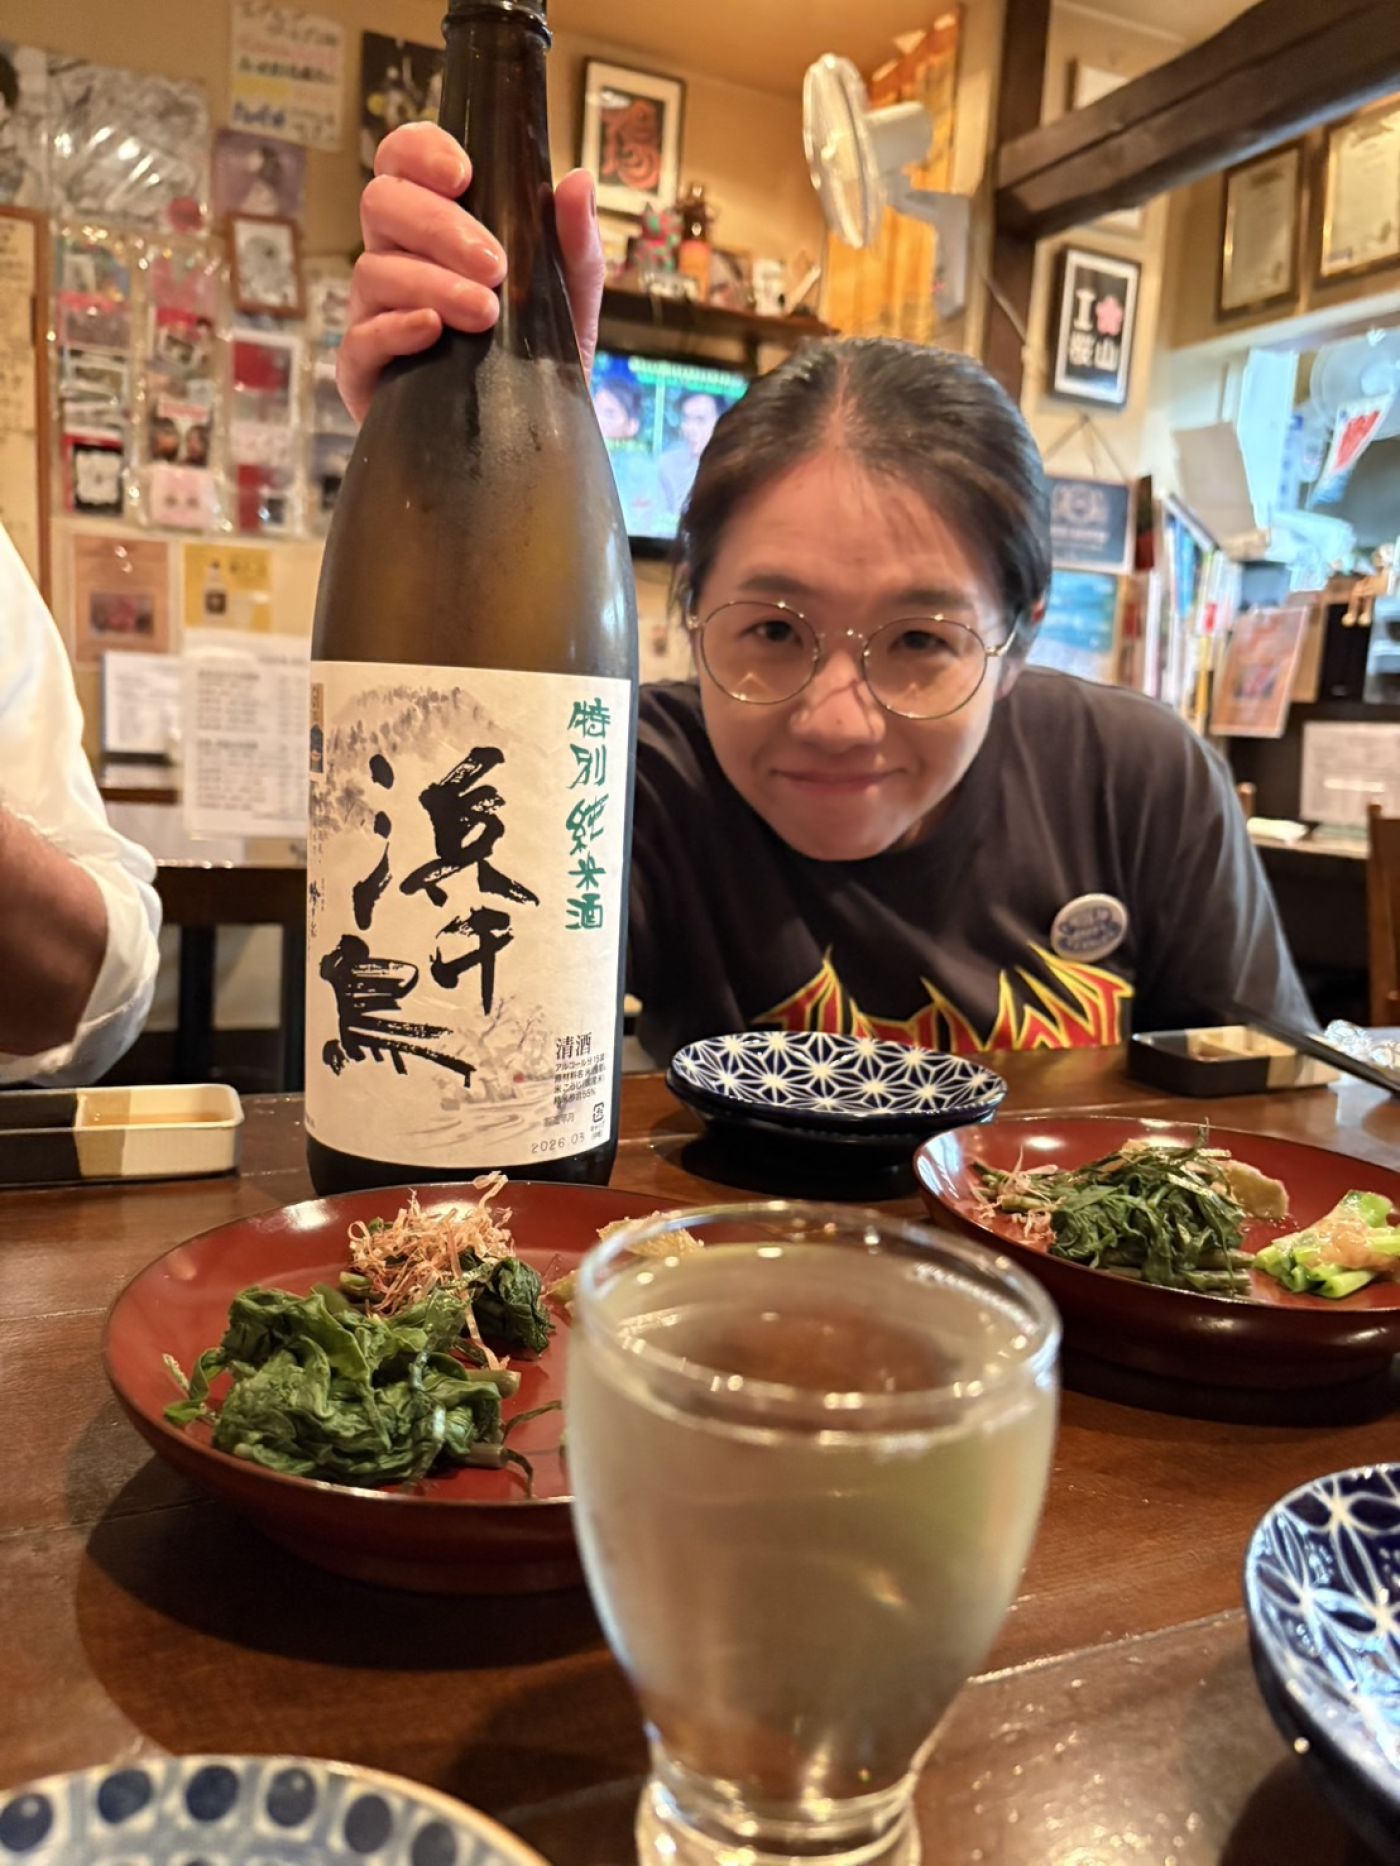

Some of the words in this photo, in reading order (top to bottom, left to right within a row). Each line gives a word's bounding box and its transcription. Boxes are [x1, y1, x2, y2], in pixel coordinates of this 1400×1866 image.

[1073, 288, 1097, 331] I
[565, 696, 610, 932] 特別純米酒
[320, 746, 540, 1088] 浜千鳥
[555, 1031, 593, 1061] 清酒
